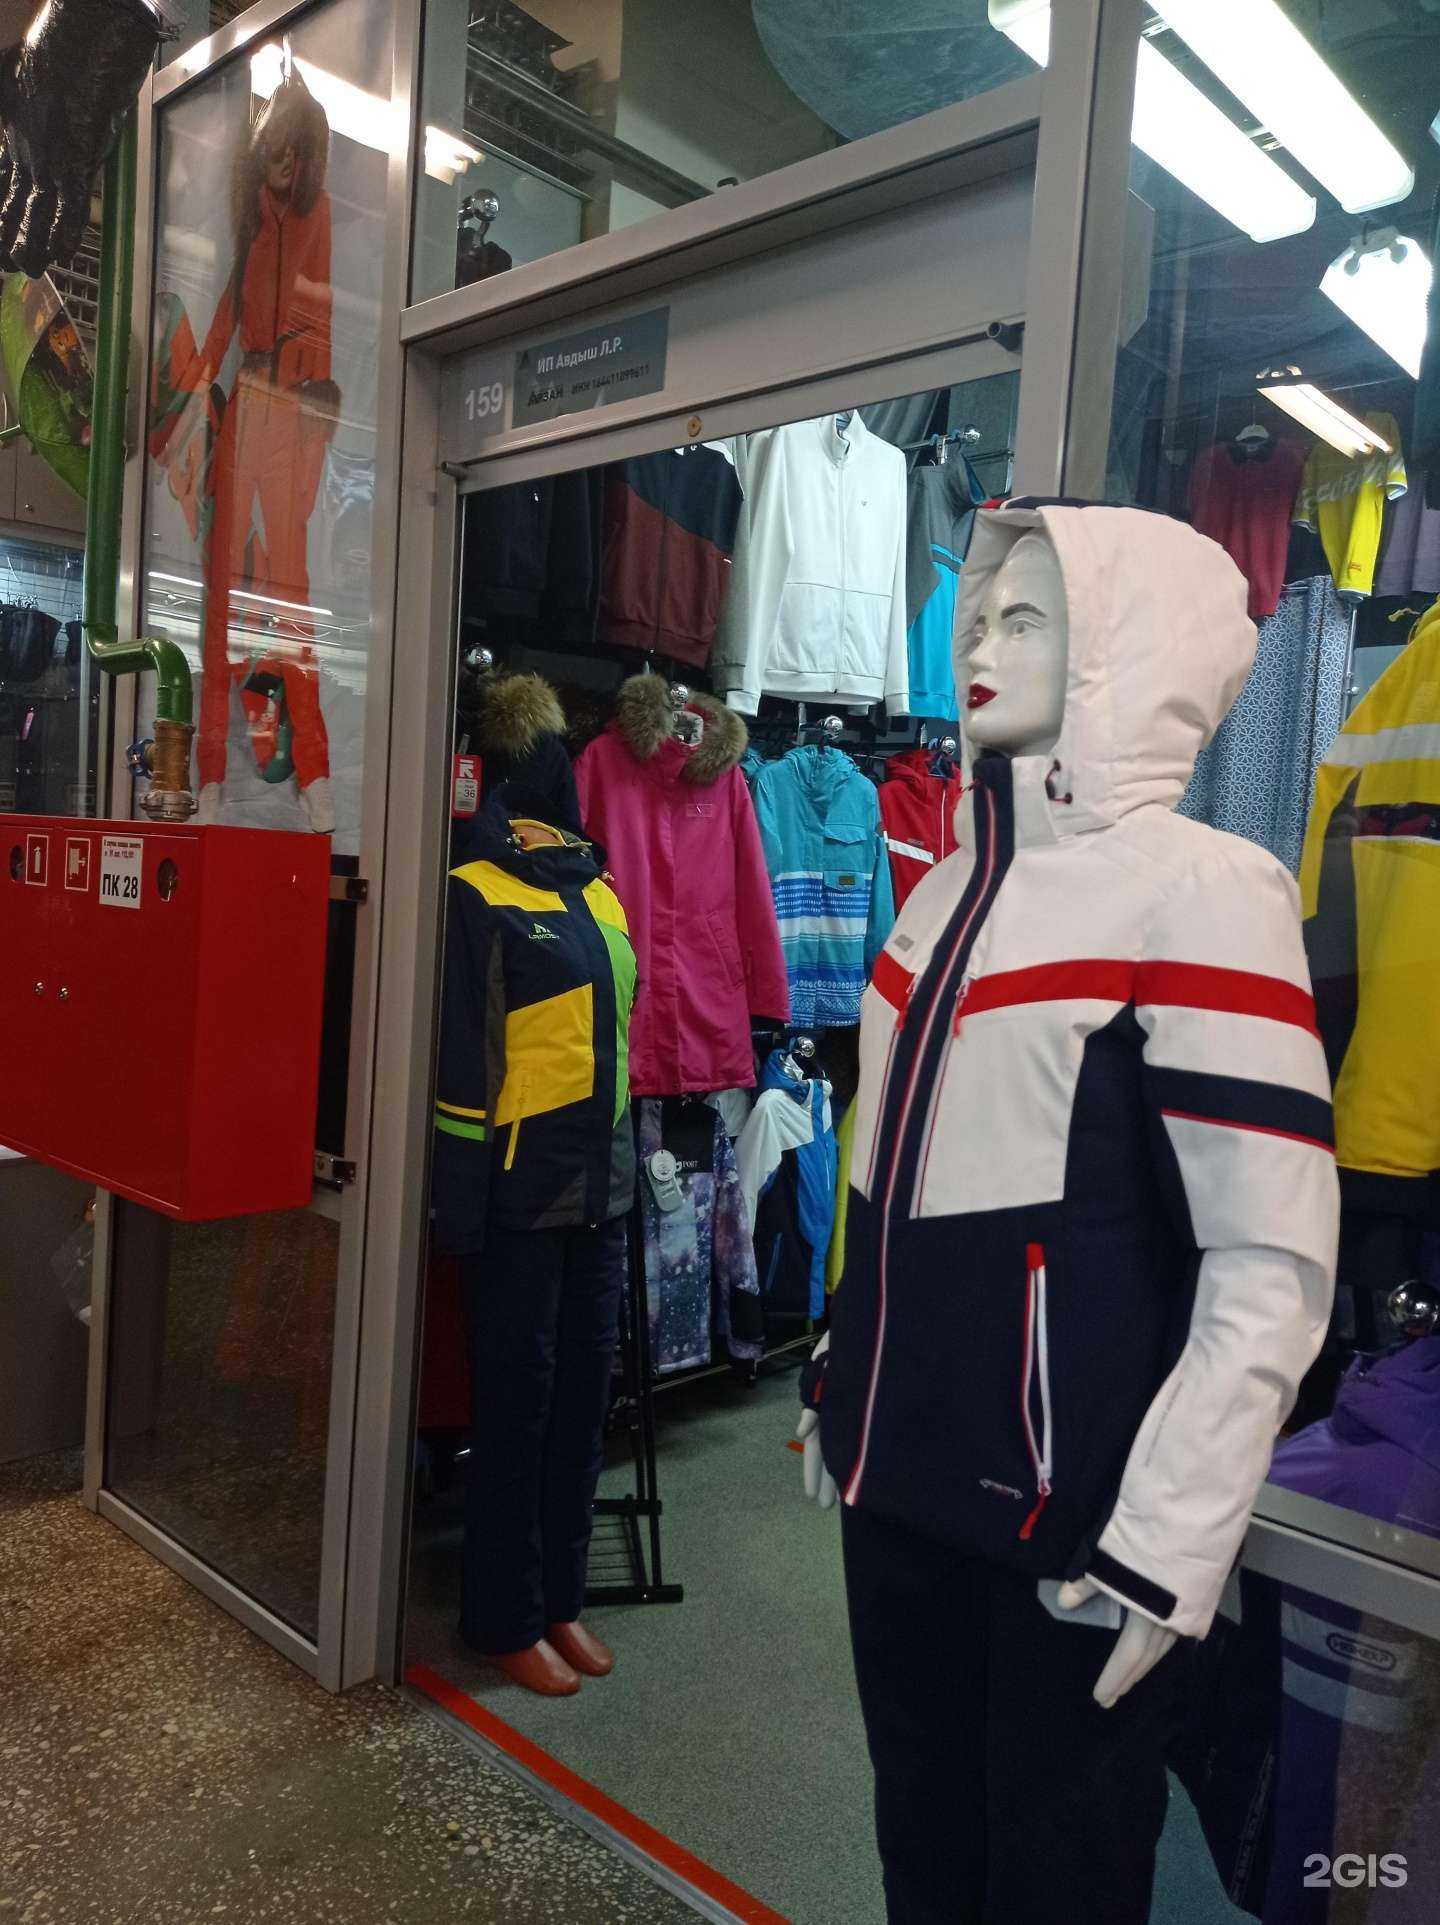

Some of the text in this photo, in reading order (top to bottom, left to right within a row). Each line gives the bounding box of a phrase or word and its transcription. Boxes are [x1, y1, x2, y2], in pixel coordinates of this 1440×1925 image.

[537, 337, 623, 374] ИП Авдыш Л.Р.
[465, 382, 504, 421] 159
[103, 873, 138, 899] ПК 28
